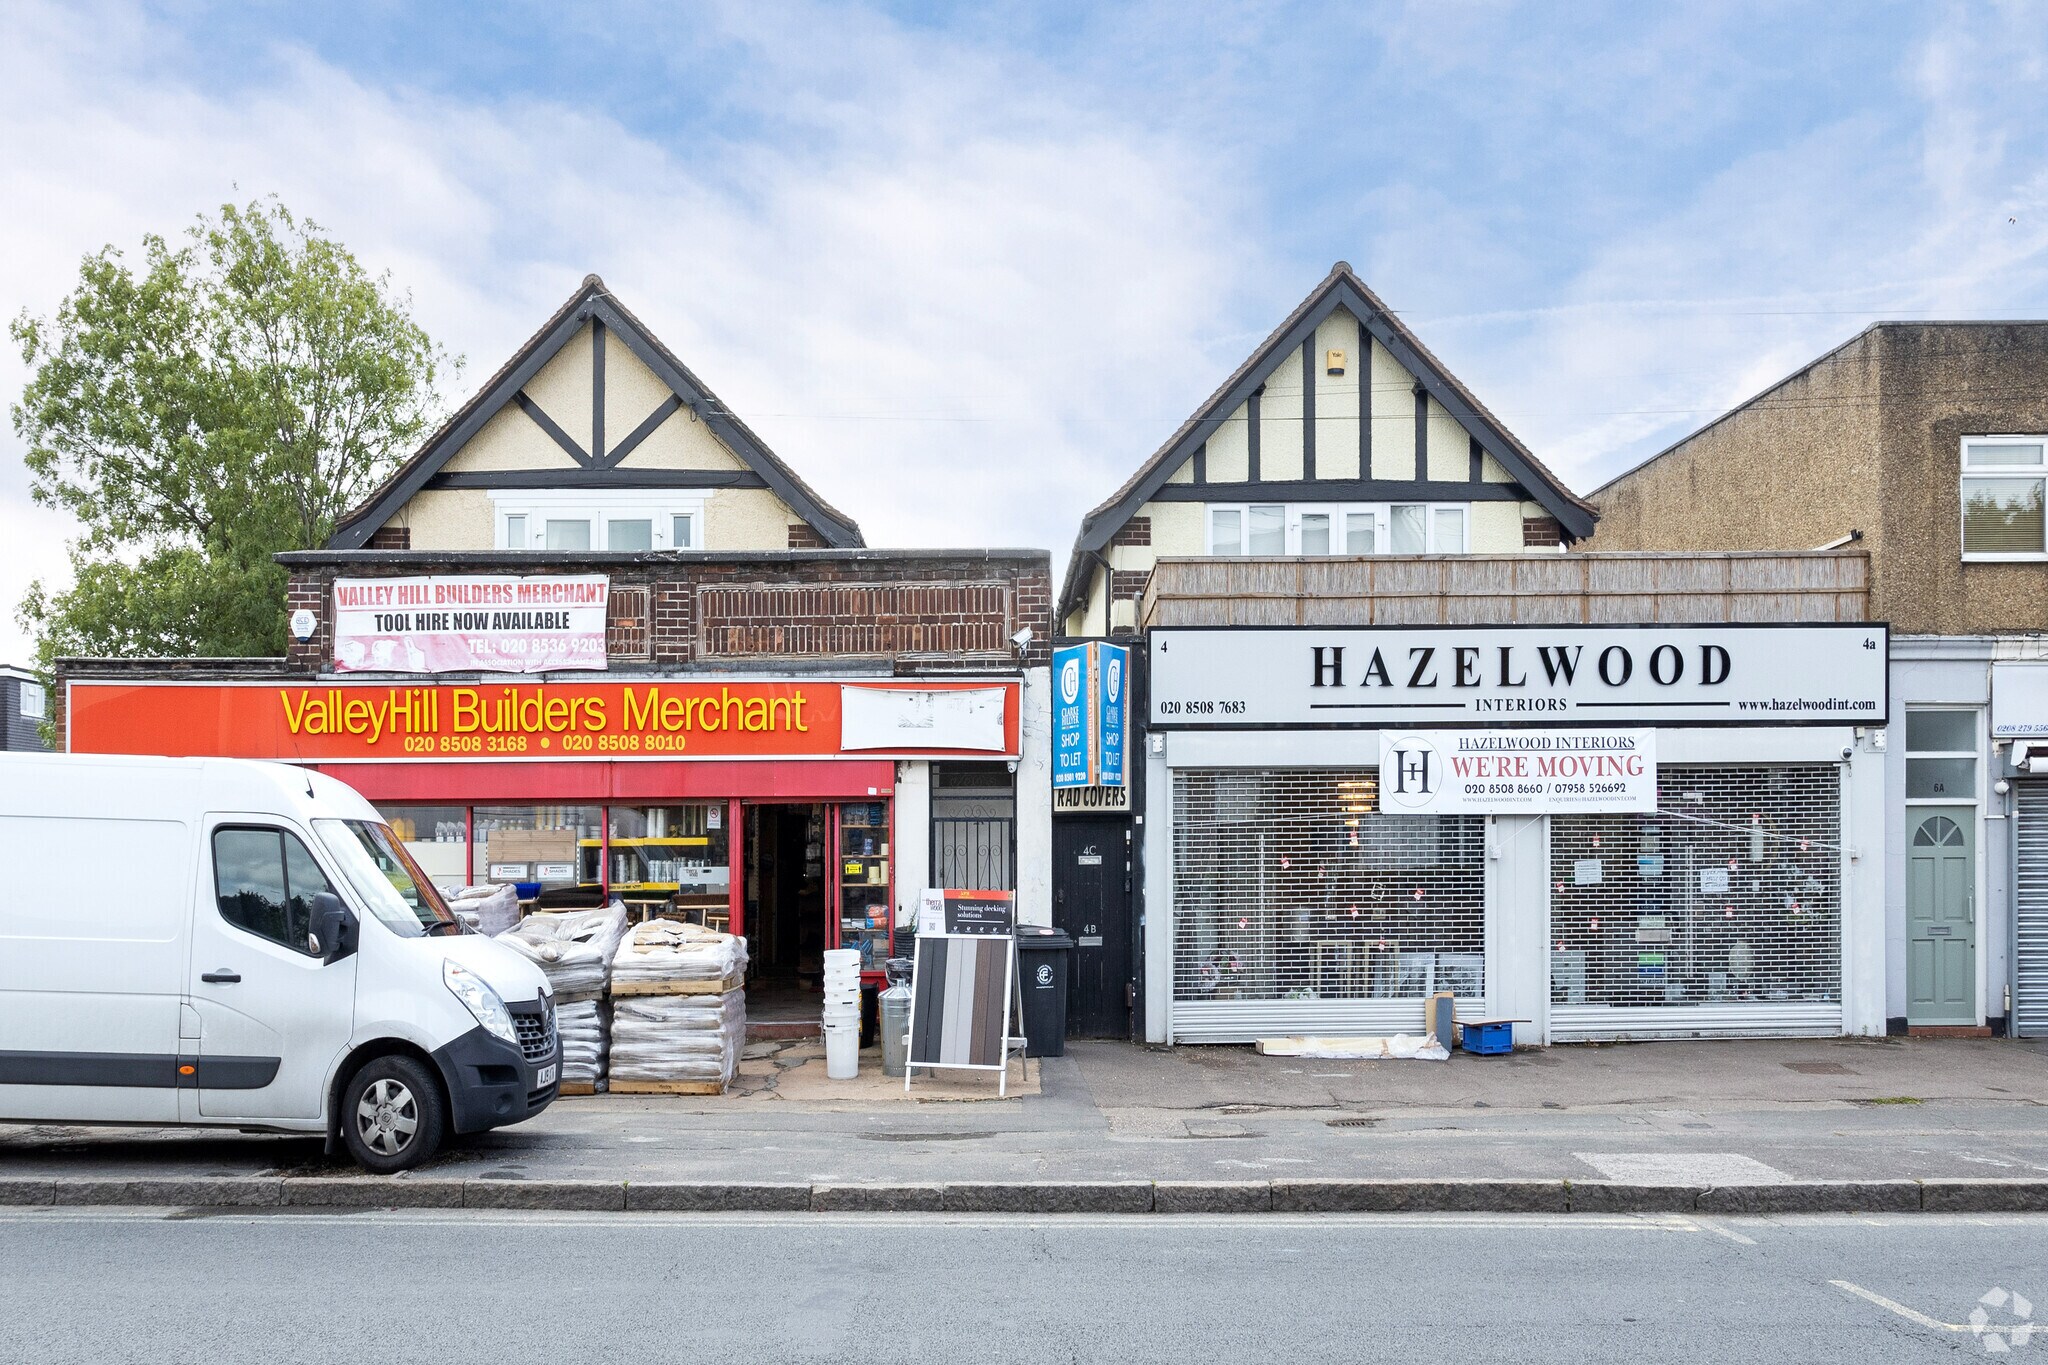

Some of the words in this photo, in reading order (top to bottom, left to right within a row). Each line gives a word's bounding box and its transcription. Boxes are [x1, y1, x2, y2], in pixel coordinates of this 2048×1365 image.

[338, 586, 393, 606] VALLEY
[398, 585, 431, 605] HILL
[435, 584, 512, 605] BUILDERS
[518, 583, 607, 603] MERCHANT
[375, 614, 411, 632] TOOL
[415, 613, 449, 631] HIRE
[453, 612, 489, 630] NOW
[493, 612, 570, 630] AVAILABLE
[468, 639, 497, 654] TEL:
[501, 638, 527, 654] 020
[532, 638, 567, 654] 8536
[571, 638, 605, 654] 9203
[1160, 641, 1168, 653] 4
[1862, 637, 1876, 650] 4a
[1310, 643, 1732, 688] HAZELWOOD
[453, 687, 607, 733] Builders
[623, 687, 808, 732] Merchant
[1160, 701, 1181, 714] 020
[1186, 701, 1214, 714] 8508
[1219, 701, 1246, 714] 7683
[1475, 698, 1568, 712] INTERIORS
[1738, 698, 1876, 711] www.hazelwoodint.com
[1996, 724, 2016, 733] 0208
[2018, 724, 2032, 733] 279
[404, 736, 435, 752] 020
[440, 736, 482, 752] 8508
[487, 736, 528, 752] 3168
[563, 735, 593, 751] 020
[598, 735, 640, 751] 8508
[645, 735, 686, 751] 8010
[1061, 732, 1080, 748] SHOP
[1106, 731, 1120, 746] SHOP
[1459, 736, 1551, 750] HAZELWOOD
[1555, 736, 1635, 750] INTERIORS
[1060, 754, 1069, 767] TO
[1070, 751, 1082, 766] LET
[1105, 751, 1112, 766] TO
[1451, 756, 1529, 778] WE'RE
[1537, 754, 1644, 778] MOVING
[1464, 784, 1485, 794] 020
[1489, 784, 1514, 794] 8508
[1517, 784, 1543, 794] 8660
[1555, 783, 1586, 794] 07958
[1589, 782, 1626, 793] 526692
[1933, 783, 1945, 793] 6A
[1057, 786, 1081, 807] RAD
[1083, 785, 1126, 807] COVERS
[1083, 845, 1097, 856] 4C
[957, 903, 983, 912] Stunning
[984, 904, 1007, 914] decking
[957, 911, 983, 919] solutions
[1083, 924, 1097, 934] 4B
